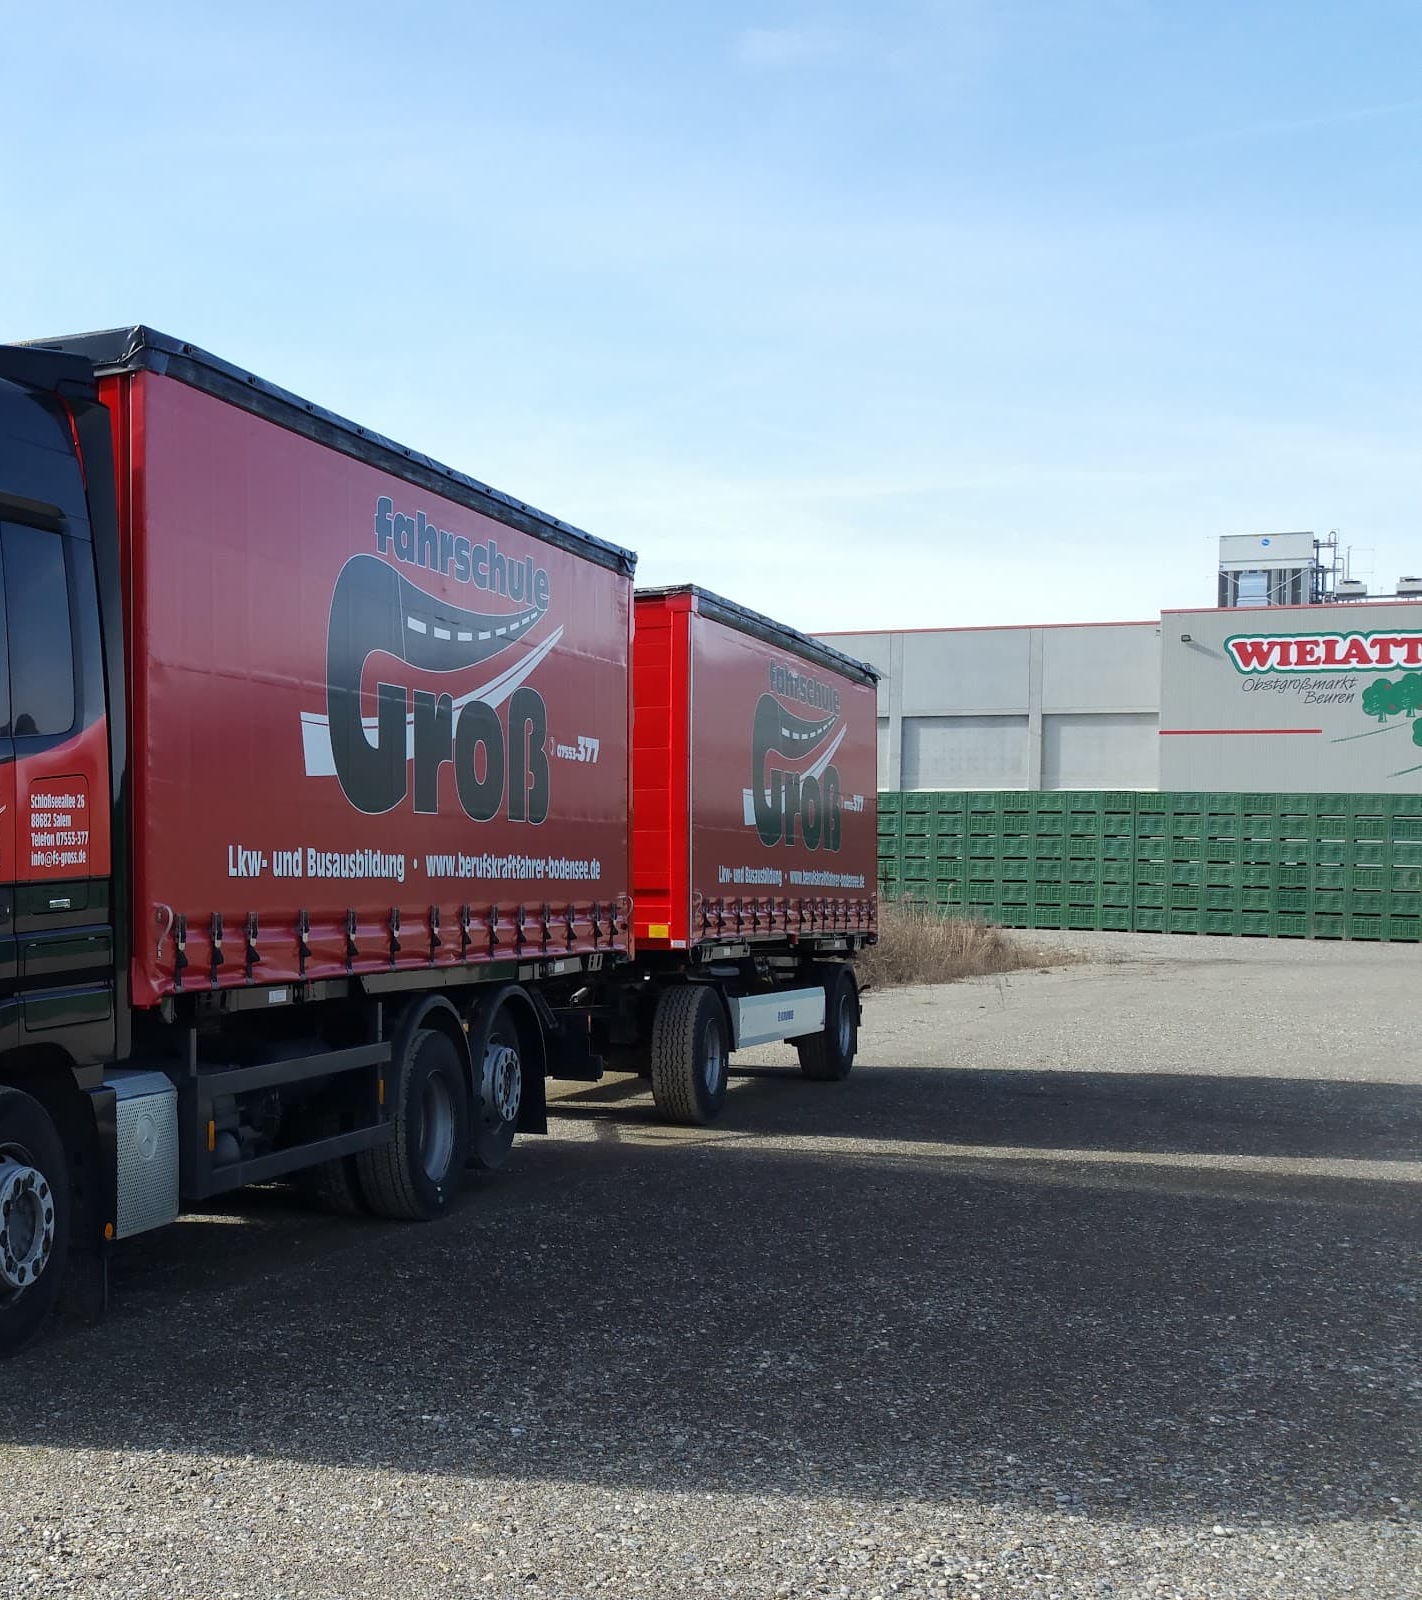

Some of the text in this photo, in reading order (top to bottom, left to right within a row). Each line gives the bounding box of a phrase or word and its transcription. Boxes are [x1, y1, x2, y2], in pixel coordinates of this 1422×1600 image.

[374, 495, 550, 611] fahrschule
[326, 553, 550, 826] Groß
[1241, 675, 1359, 694] Obstgroßmarkt
[1303, 690, 1355, 704] Beuren
[752, 692, 842, 853] Groß
[76, 794, 85, 809] 26
[30, 812, 72, 828] 88682 Salem
[31, 832, 55, 847] Telefon
[31, 849, 87, 868] info@fs-gross.de
[228, 845, 601, 882] Lkw- und Busausbildung www.berufskraftfahrer-bodensee.de
